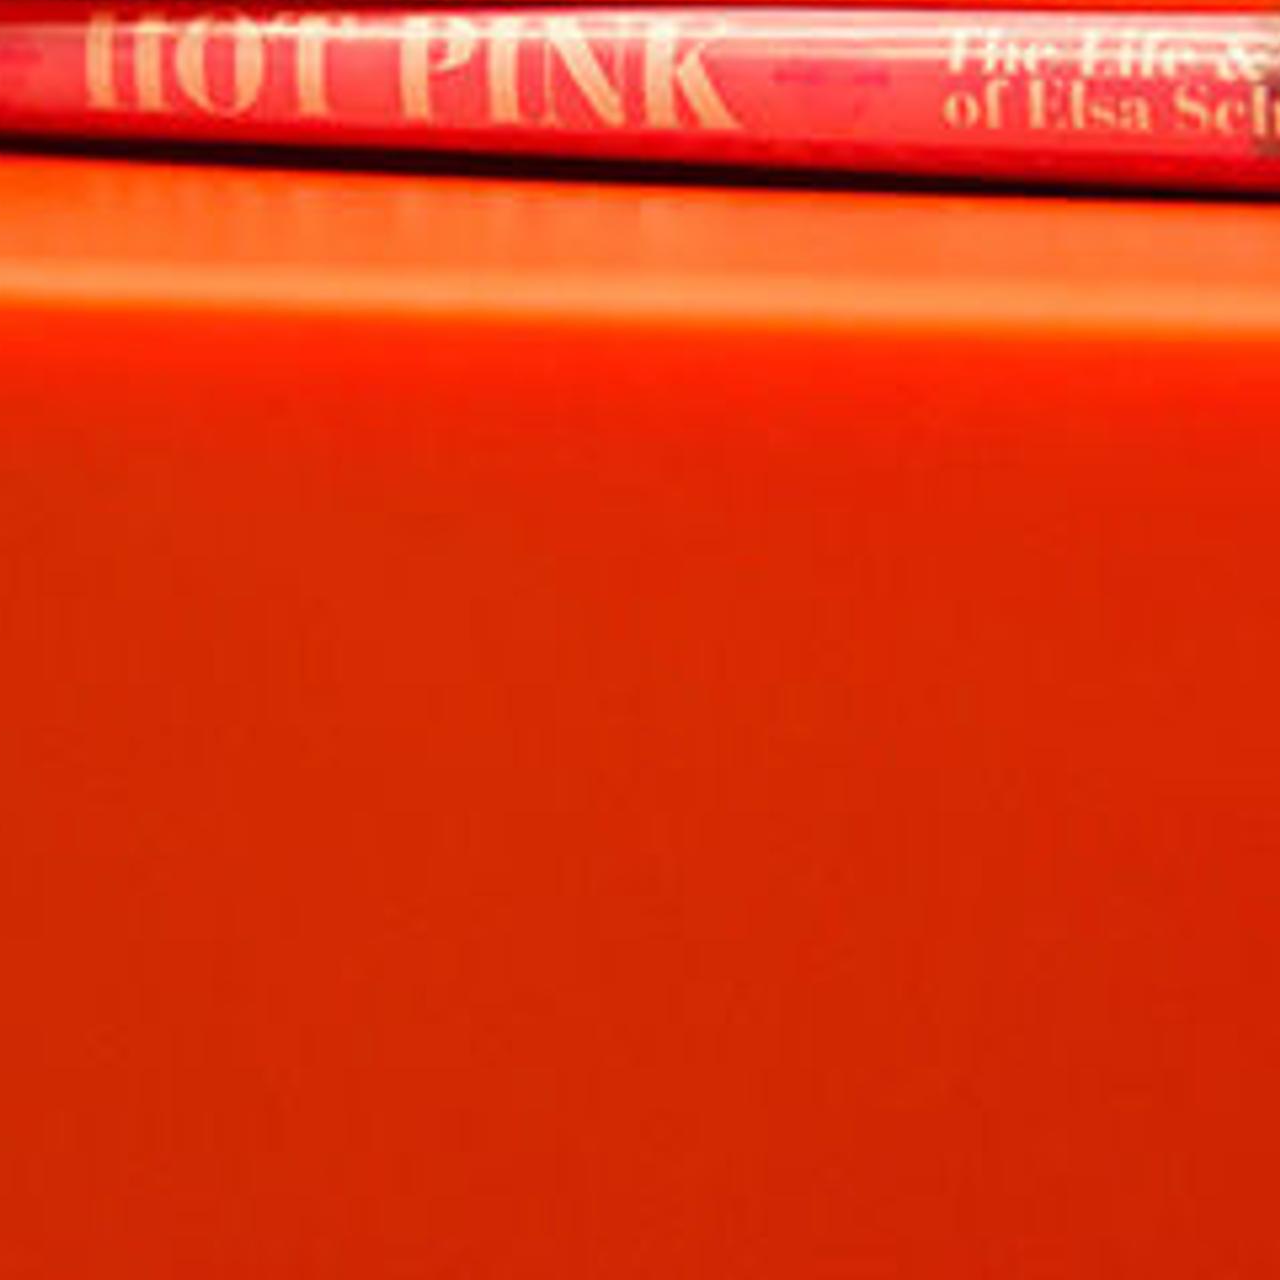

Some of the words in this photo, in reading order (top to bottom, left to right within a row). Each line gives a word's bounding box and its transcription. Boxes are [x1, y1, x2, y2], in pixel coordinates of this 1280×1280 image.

[84, 10, 356, 122] HOT
[400, 14, 744, 132] PINK
[944, 78, 1010, 131] of
[1026, 80, 1152, 136] Elsa
